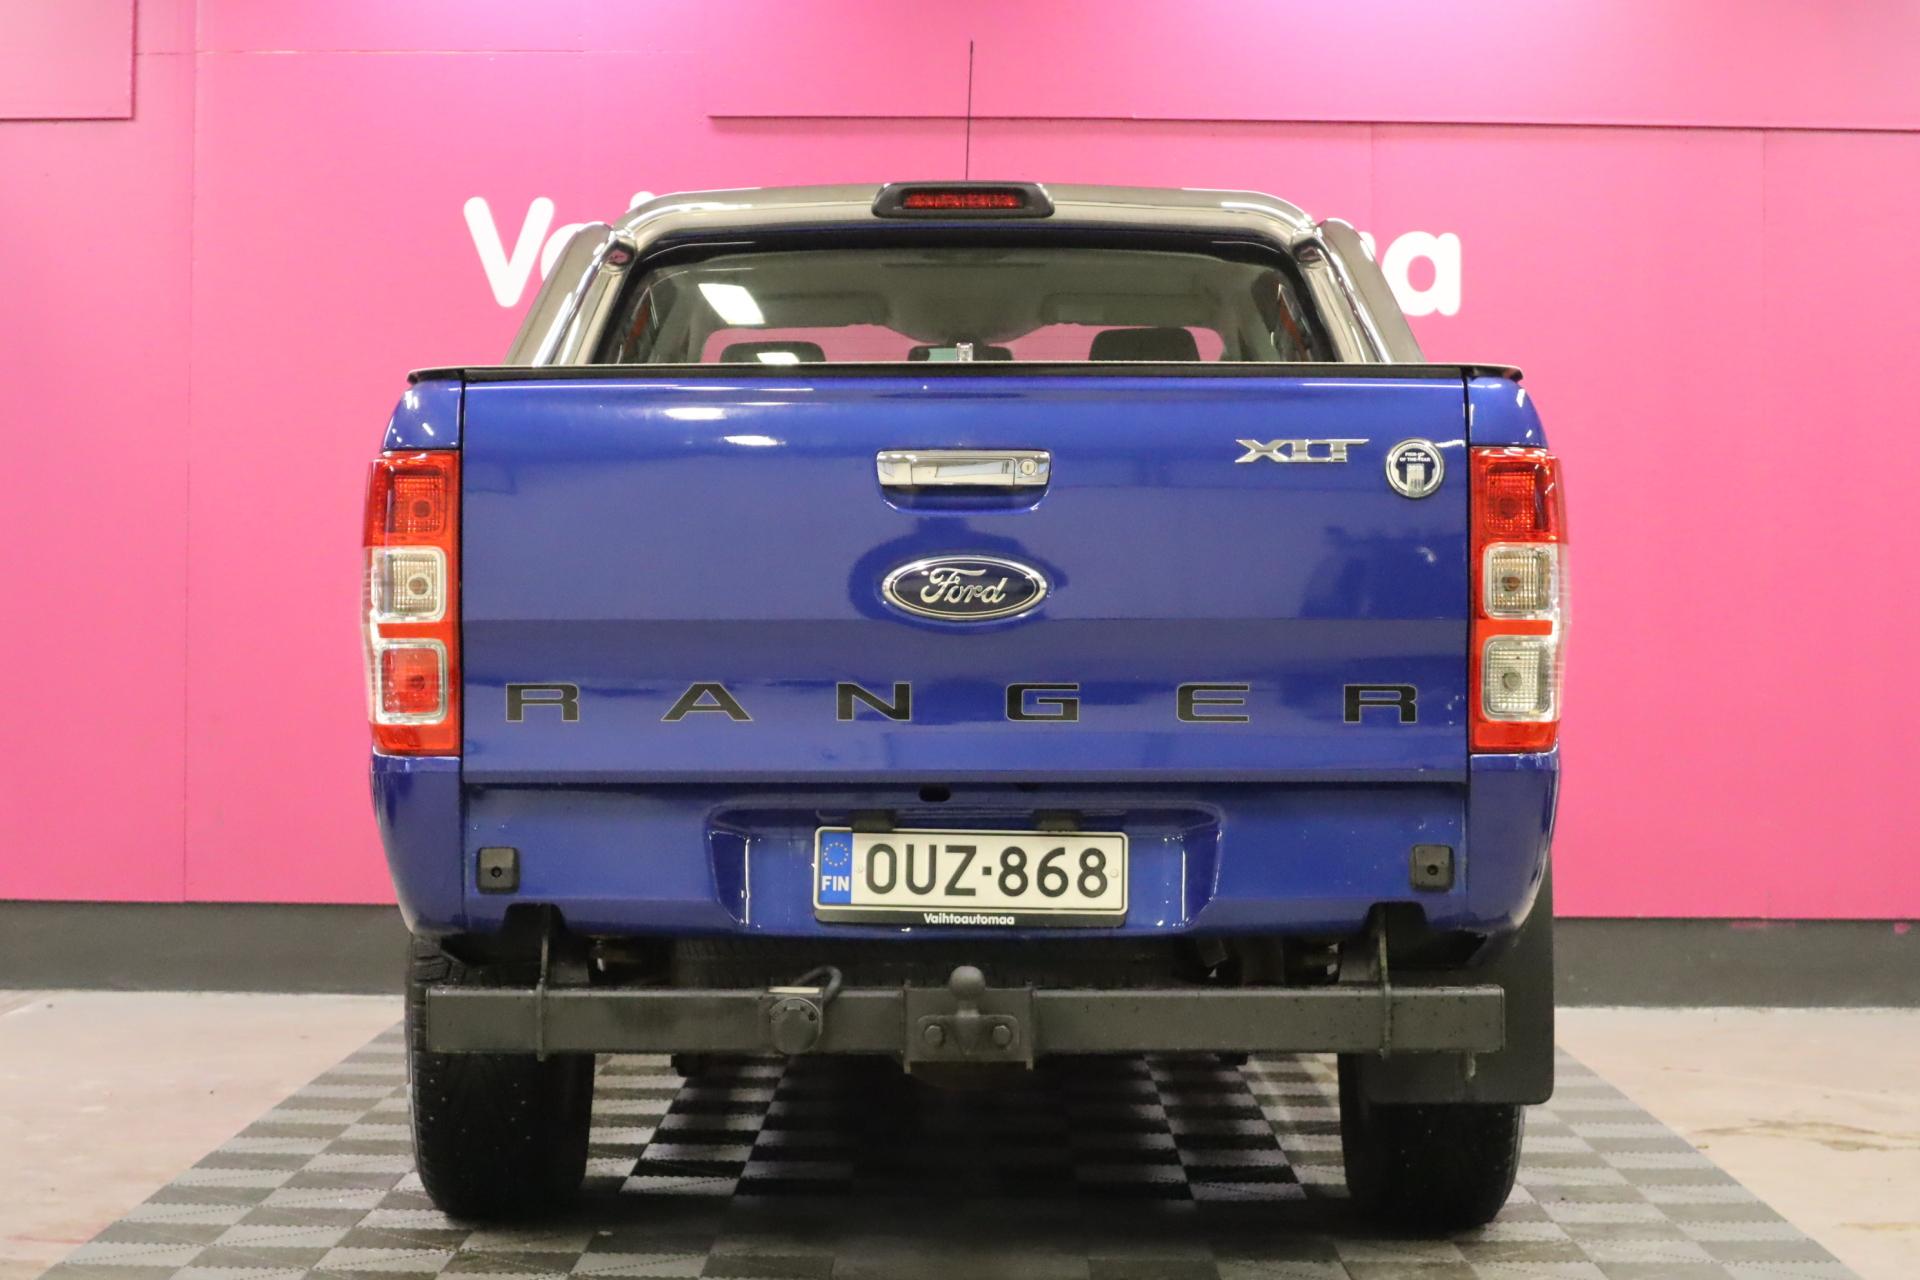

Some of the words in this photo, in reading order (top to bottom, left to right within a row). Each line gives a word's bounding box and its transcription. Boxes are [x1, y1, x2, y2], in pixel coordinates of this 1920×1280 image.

[1234, 438, 1370, 463] XLT
[920, 567, 1009, 604] Ford
[505, 682, 1418, 722] RANGER
[820, 875, 850, 892] FIN
[865, 843, 1108, 899] OUZ-868
[923, 912, 1015, 925] Vaihtoautomaa
